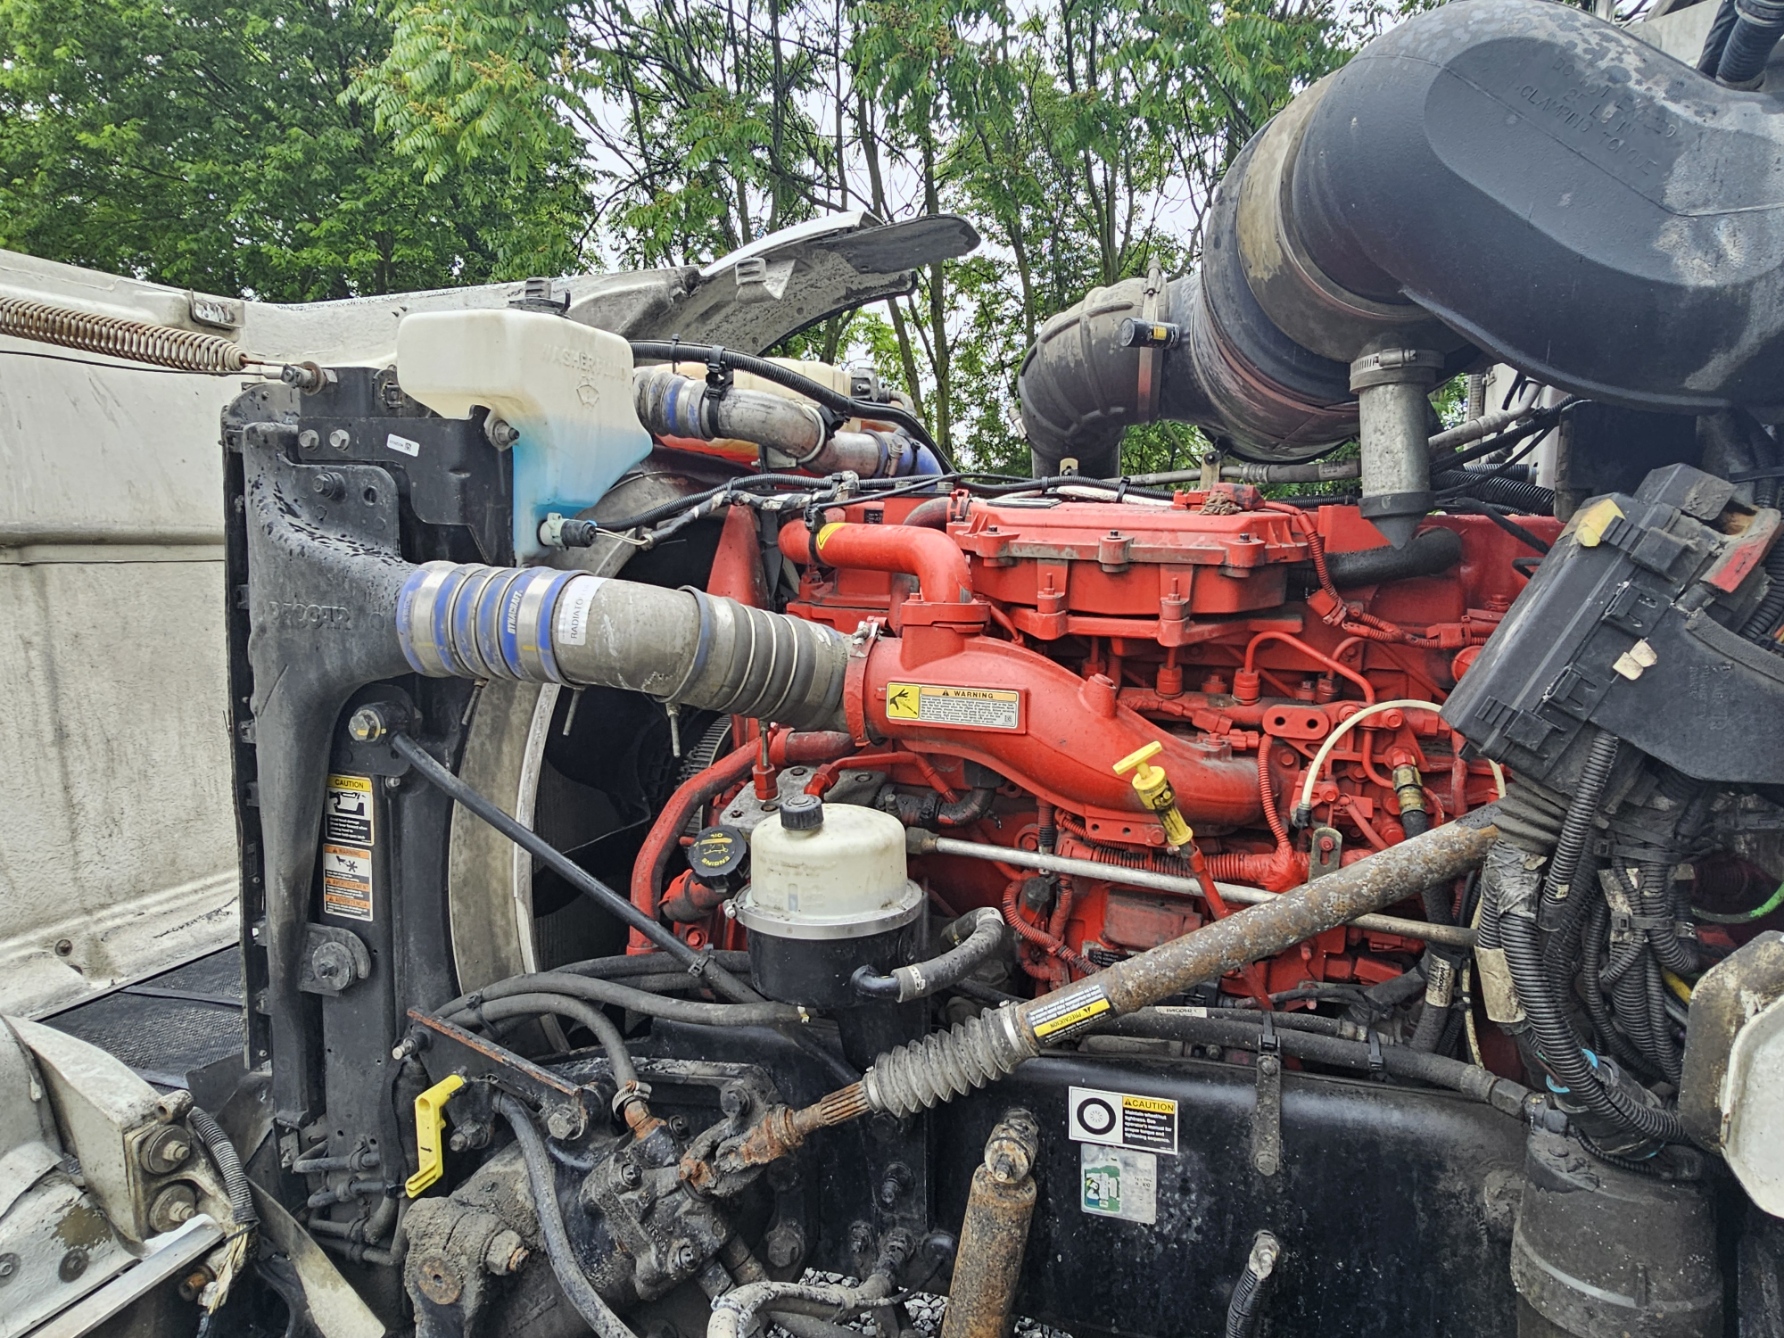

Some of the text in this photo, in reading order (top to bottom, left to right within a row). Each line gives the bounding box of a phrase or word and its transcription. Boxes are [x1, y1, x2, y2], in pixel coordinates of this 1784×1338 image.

[1520, 85, 1594, 133] CLAMPING
[953, 690, 994, 699] WARNING
[334, 778, 364, 789] CAUTION
[701, 855, 731, 867] ENGINE
[1132, 1099, 1174, 1112] CAUTION
